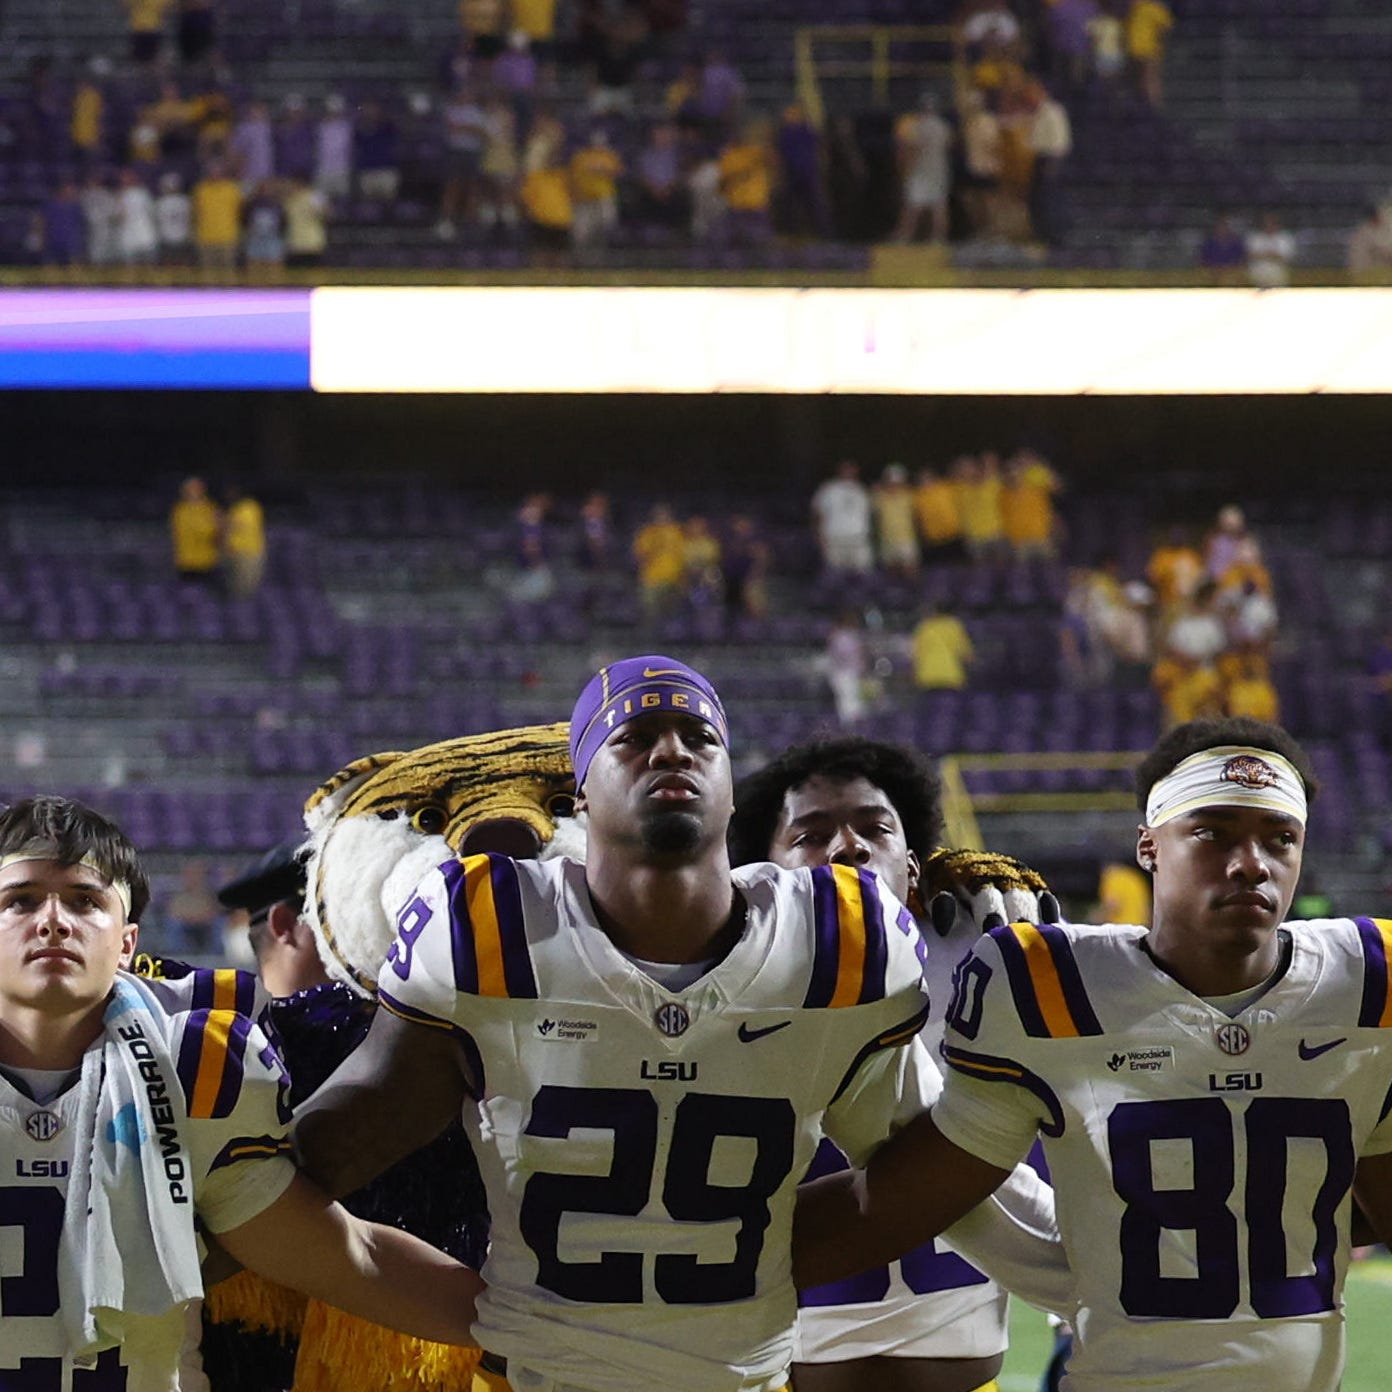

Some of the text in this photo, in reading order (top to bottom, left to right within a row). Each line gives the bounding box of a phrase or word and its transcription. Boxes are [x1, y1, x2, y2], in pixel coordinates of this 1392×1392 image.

[1218, 1024, 1249, 1055] SEC
[1127, 1051, 1172, 1061] Woodside
[1129, 1061, 1162, 1072] Energy
[640, 1060, 698, 1082] LSU
[1208, 1072, 1263, 1091] LSU
[118, 1018, 189, 1205] POWERADE
[27, 1111, 60, 1141] SEC
[16, 1159, 69, 1177] LSU
[520, 1085, 797, 1305] 29
[1108, 1096, 1355, 1319] 80
